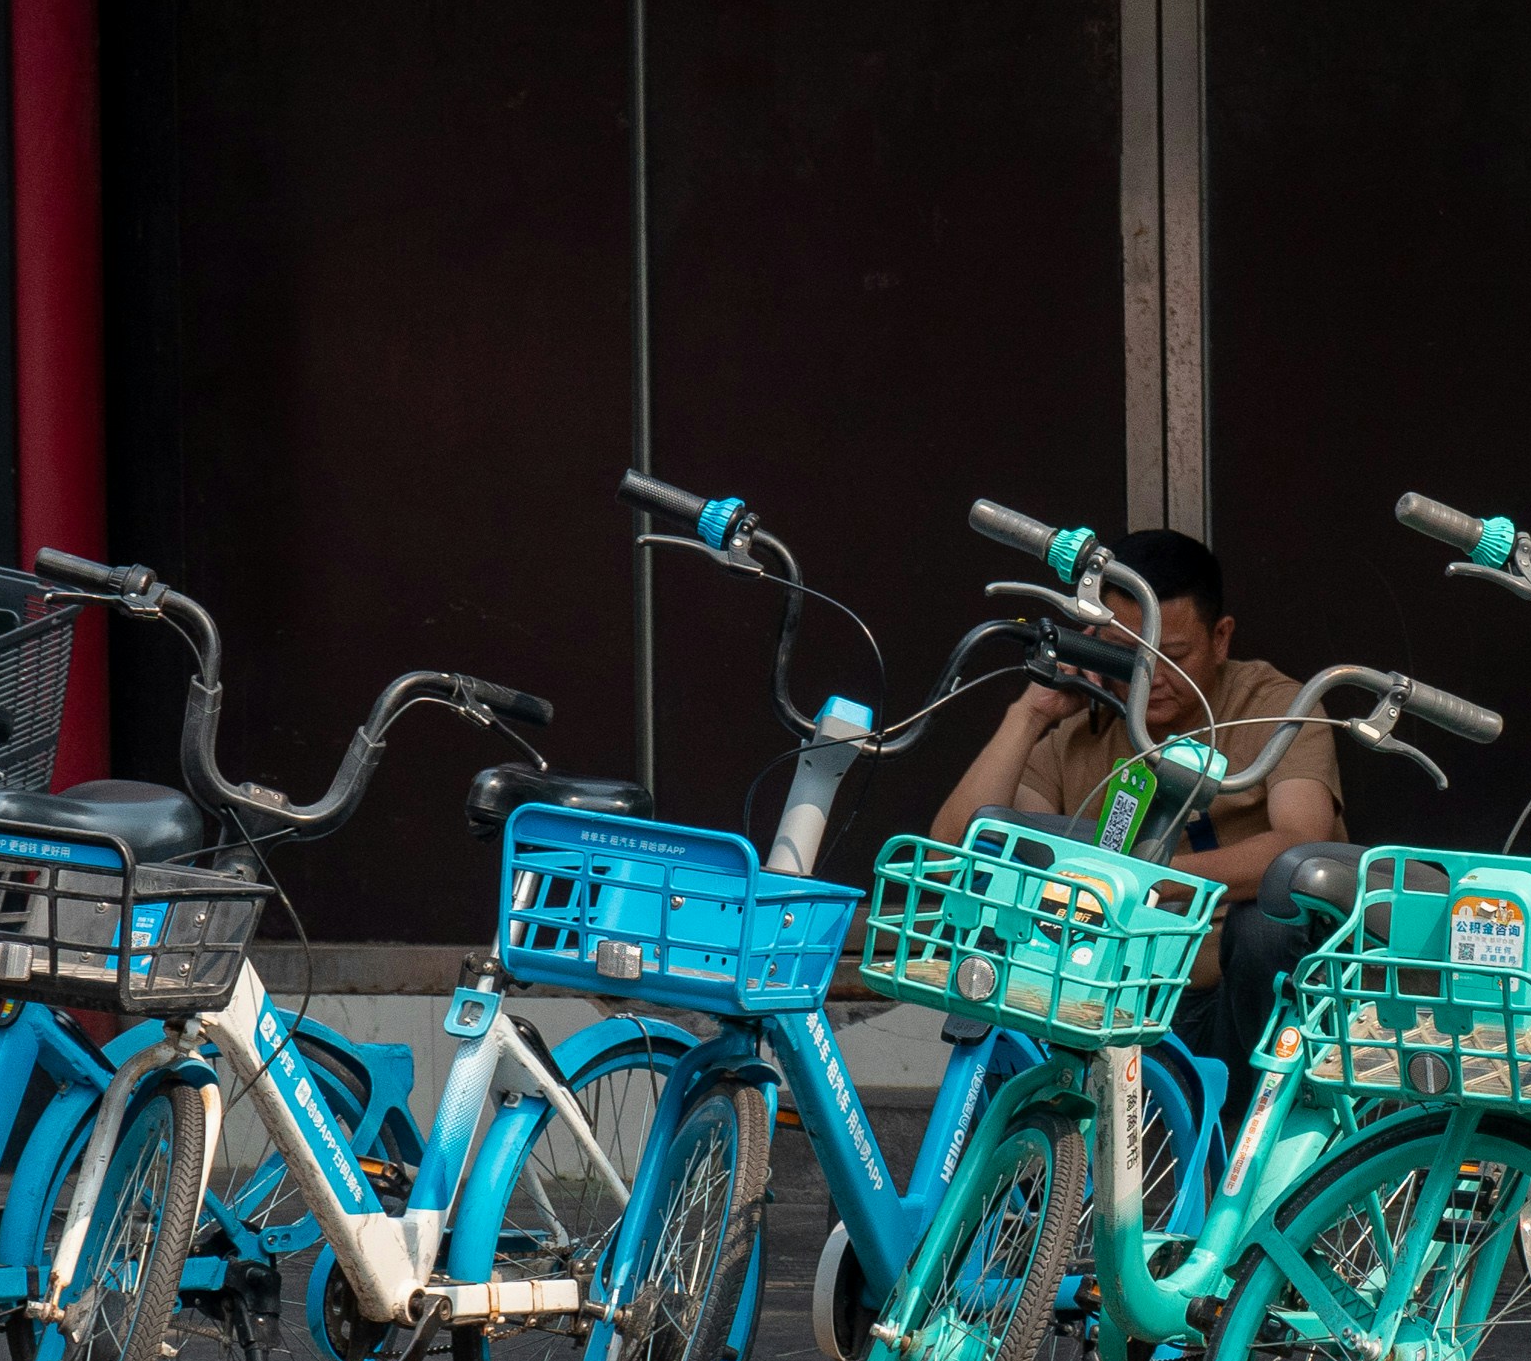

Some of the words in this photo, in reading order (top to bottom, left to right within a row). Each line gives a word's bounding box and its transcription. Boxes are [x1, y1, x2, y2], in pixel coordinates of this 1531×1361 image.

[1456, 920, 1521, 937] 公积金咨询
